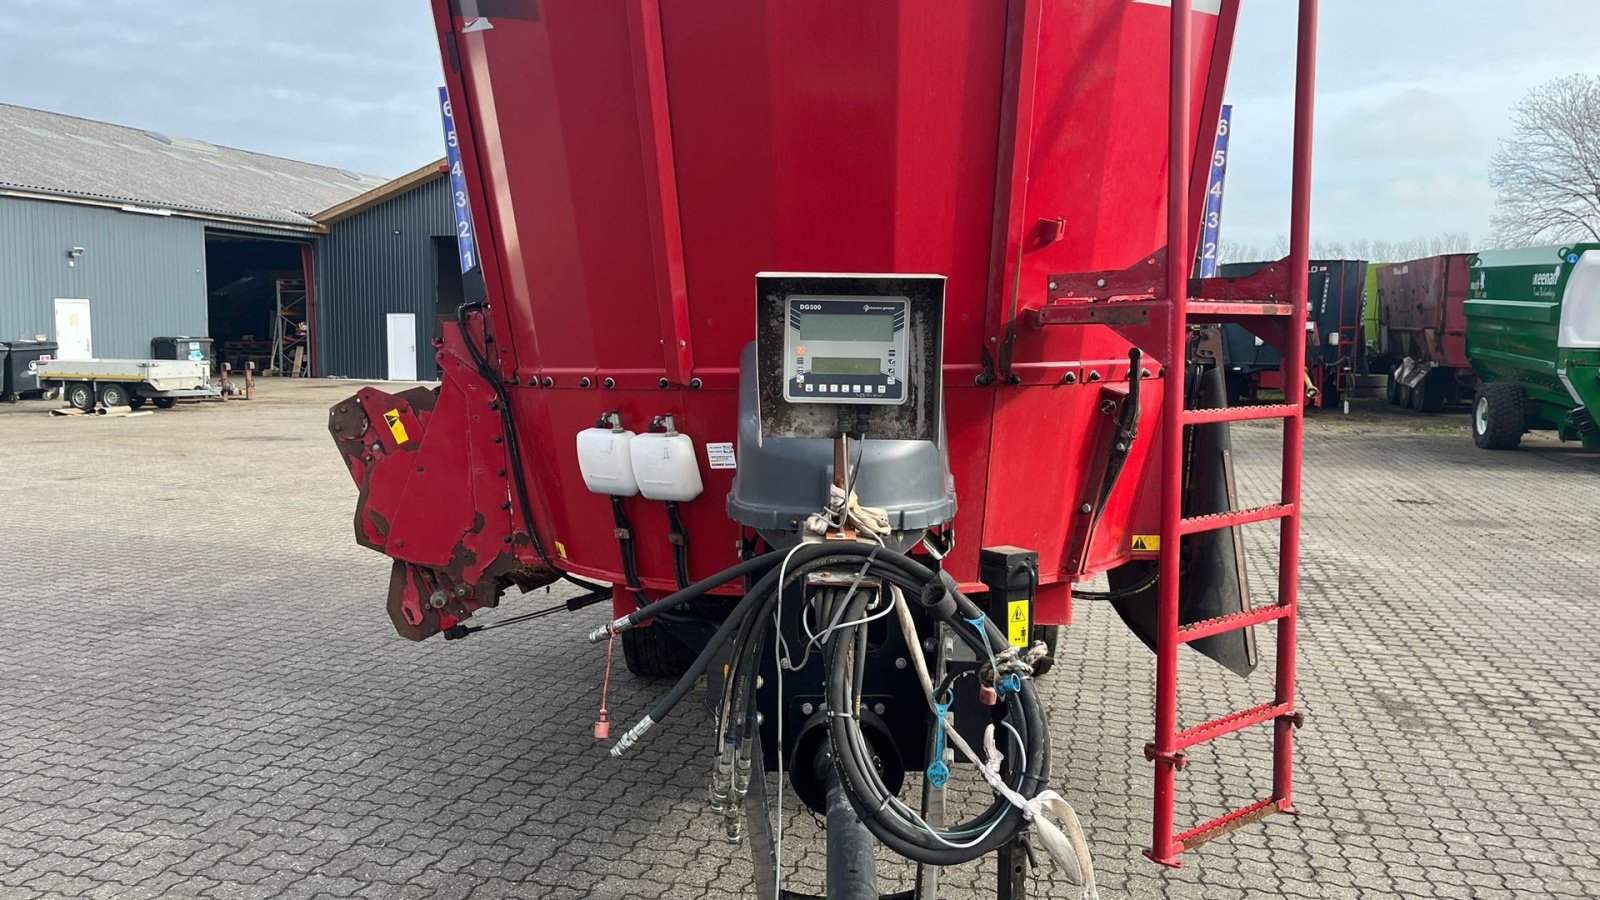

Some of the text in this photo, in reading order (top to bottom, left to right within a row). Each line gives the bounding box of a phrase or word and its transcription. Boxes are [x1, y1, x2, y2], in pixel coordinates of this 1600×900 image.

[443, 101, 452, 117] 6
[1218, 119, 1228, 136] 6
[447, 131, 457, 147] 5
[1214, 150, 1225, 167] 5
[452, 161, 462, 176] 4
[1210, 181, 1221, 197] 4
[455, 191, 466, 207] 3
[1208, 212, 1218, 228] 3
[459, 221, 470, 237] 2
[1204, 243, 1216, 258] 2
[464, 251, 473, 267] 1
